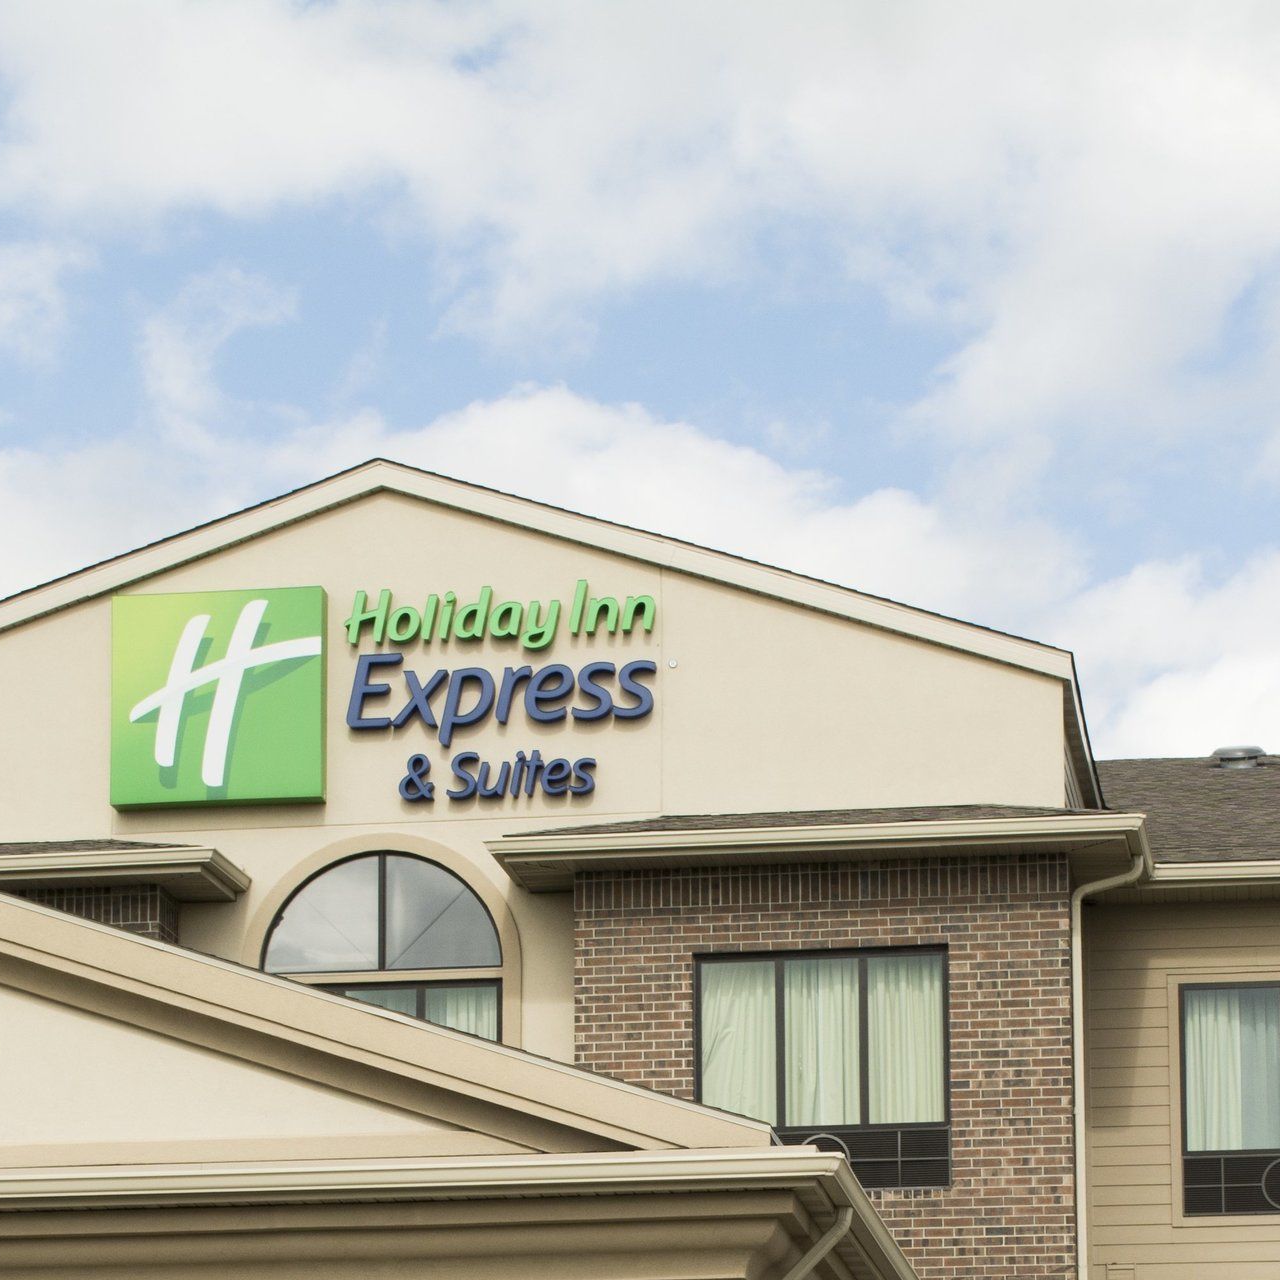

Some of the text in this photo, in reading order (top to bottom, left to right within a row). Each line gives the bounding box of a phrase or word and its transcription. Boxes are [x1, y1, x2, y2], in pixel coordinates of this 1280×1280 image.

[345, 579, 658, 651] Holiday Inn
[346, 653, 658, 748] Express
[399, 749, 597, 802] & Suites
